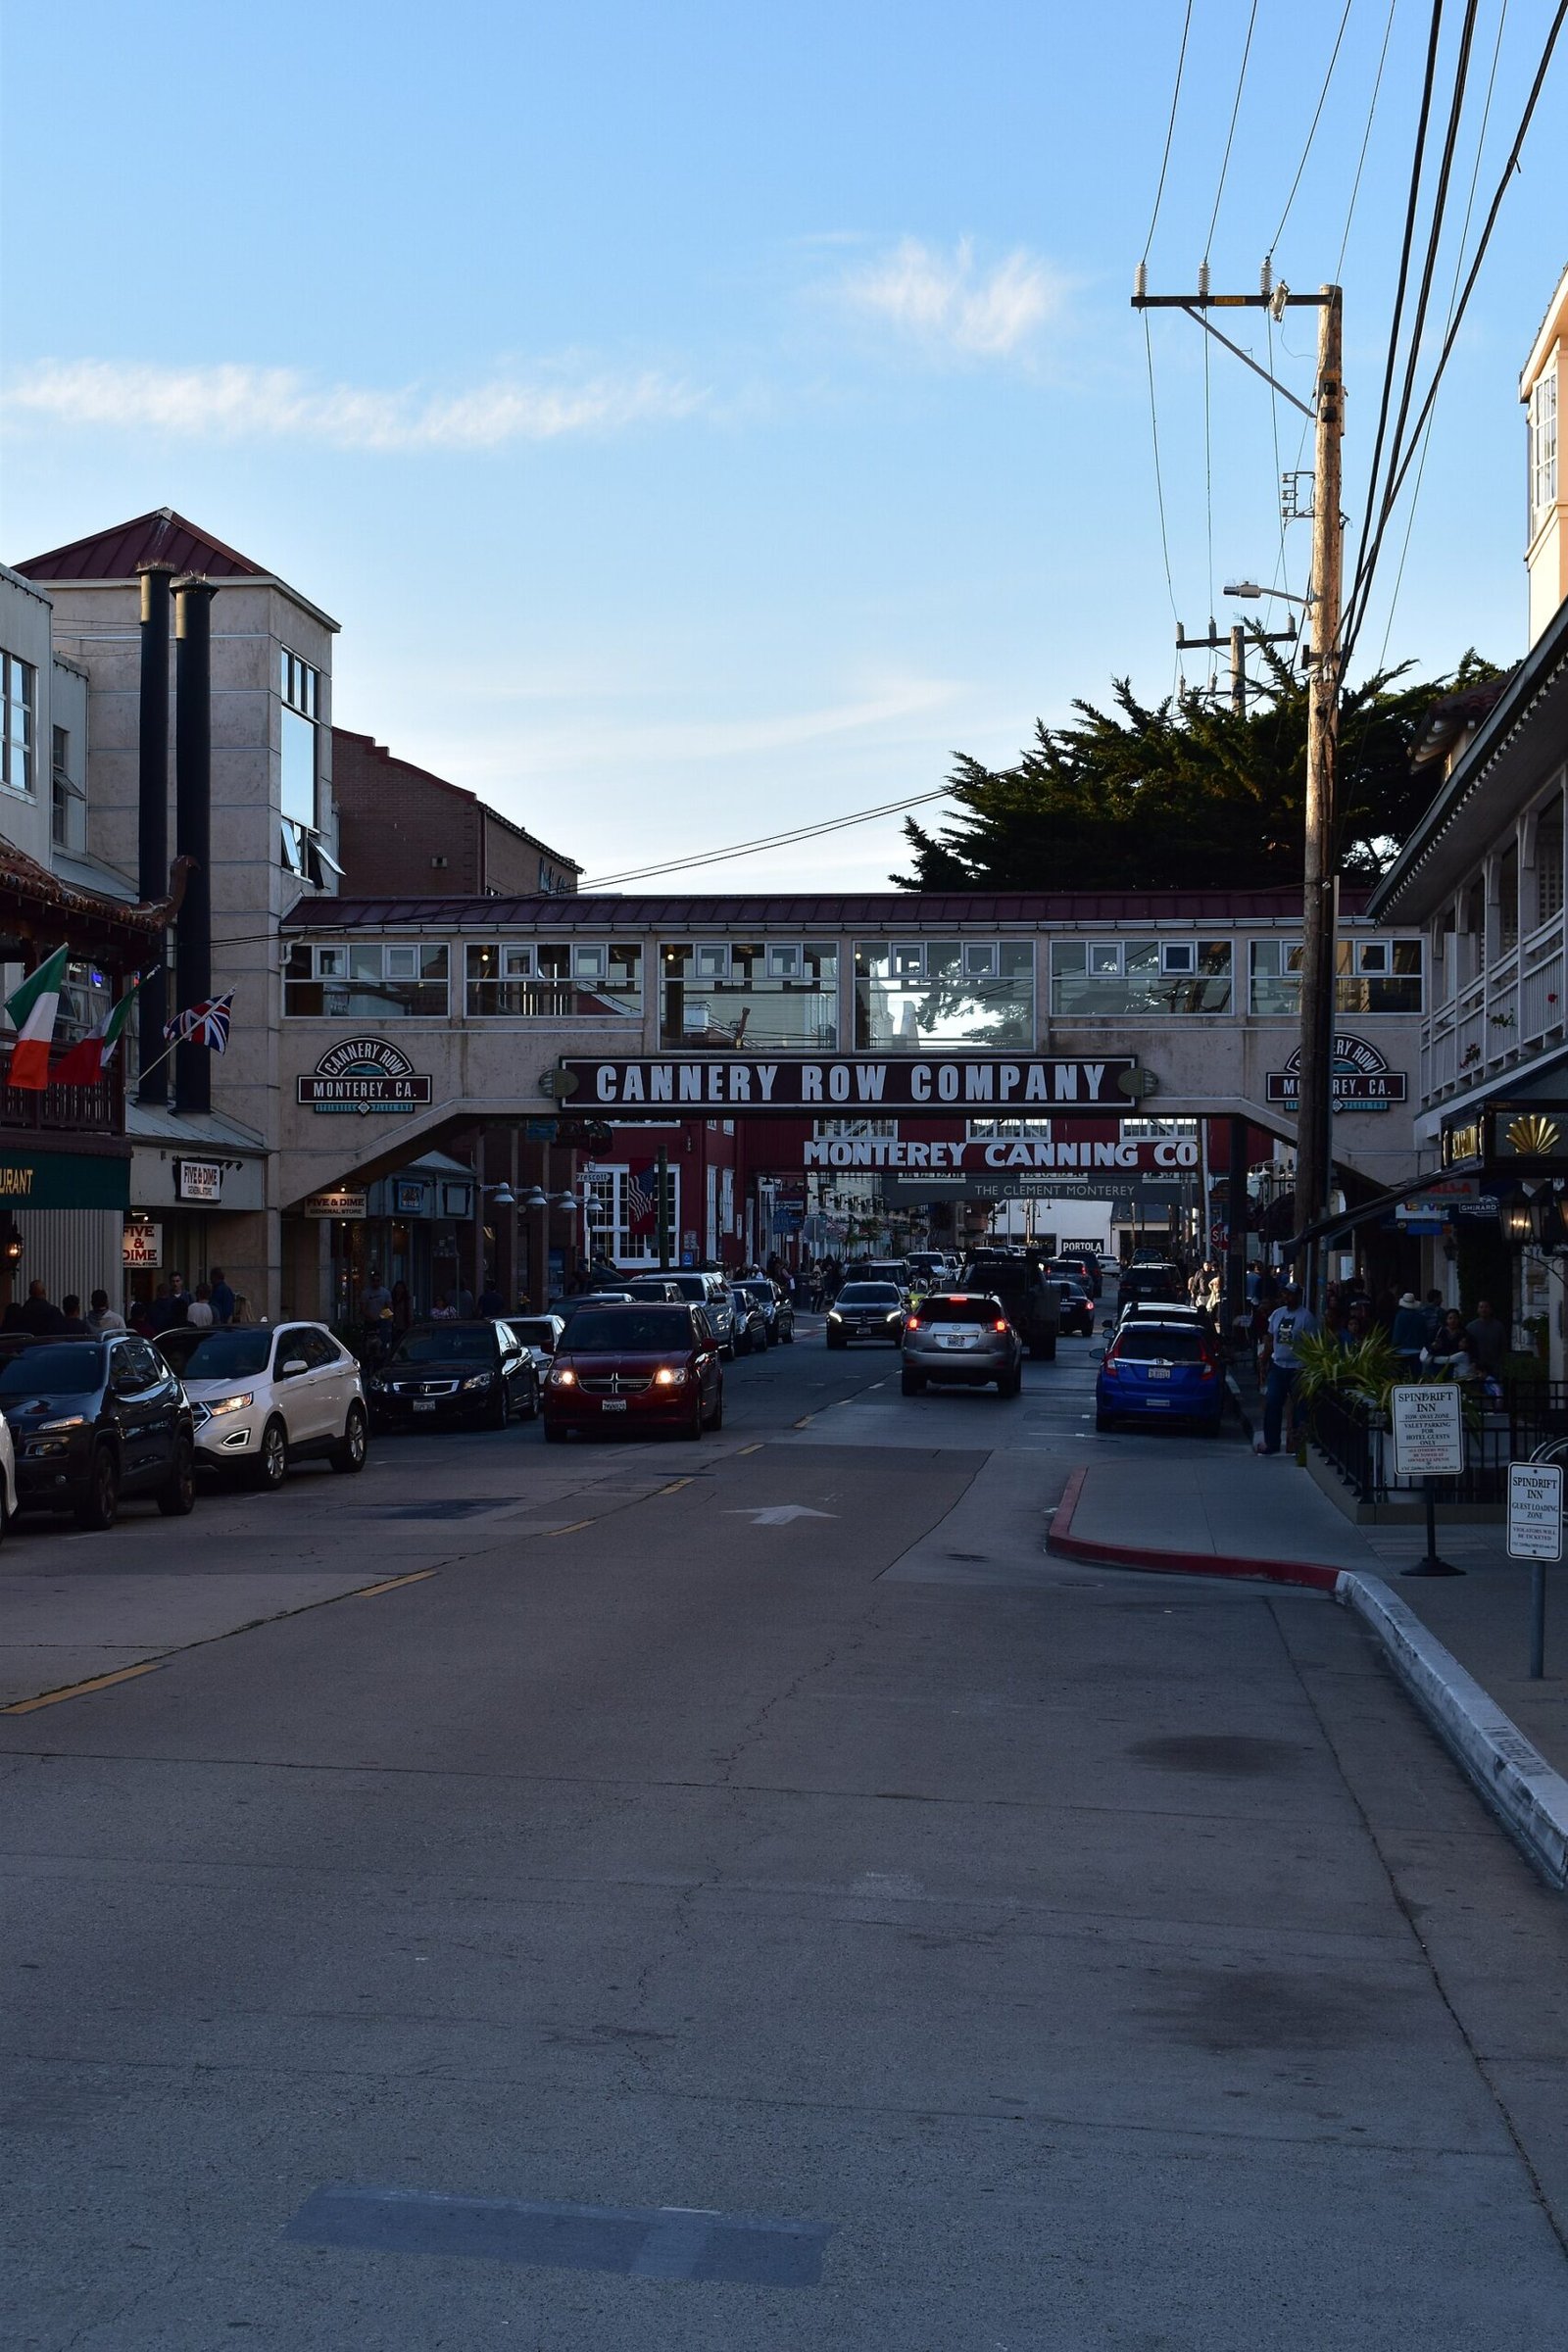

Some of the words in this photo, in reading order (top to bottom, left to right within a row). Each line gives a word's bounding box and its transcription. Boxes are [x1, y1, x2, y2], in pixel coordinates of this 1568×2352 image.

[324, 1042, 380, 1075] CANNERY
[378, 1049, 406, 1075] ROW
[1351, 1045, 1380, 1072] ROW
[596, 1064, 779, 1102] CANNERY
[801, 1064, 887, 1102] ROW
[910, 1064, 1105, 1102] COMPANY
[1368, 1079, 1392, 1096] CA.
[314, 1081, 389, 1099] MONTEREY,
[395, 1081, 416, 1098] CA.
[803, 1141, 967, 1167] MONTEREY
[985, 1142, 1138, 1167] CANNING
[1153, 1142, 1199, 1167] CO
[975, 1185, 999, 1196] THE
[1004, 1185, 1061, 1197] CLEMENT
[1066, 1185, 1135, 1197] MONTEREY
[122, 1225, 155, 1237] FIVE
[133, 1237, 144, 1250] &
[1062, 1242, 1103, 1253] PORTOLA
[122, 1249, 157, 1261] DIME
[1397, 1392, 1453, 1402] SPINDRIFT
[1416, 1403, 1436, 1412] INN
[1512, 1476, 1557, 1490] SPINDRIFT
[1527, 1489, 1544, 1499] INN
[1532, 1503, 1558, 1512] LOADING
